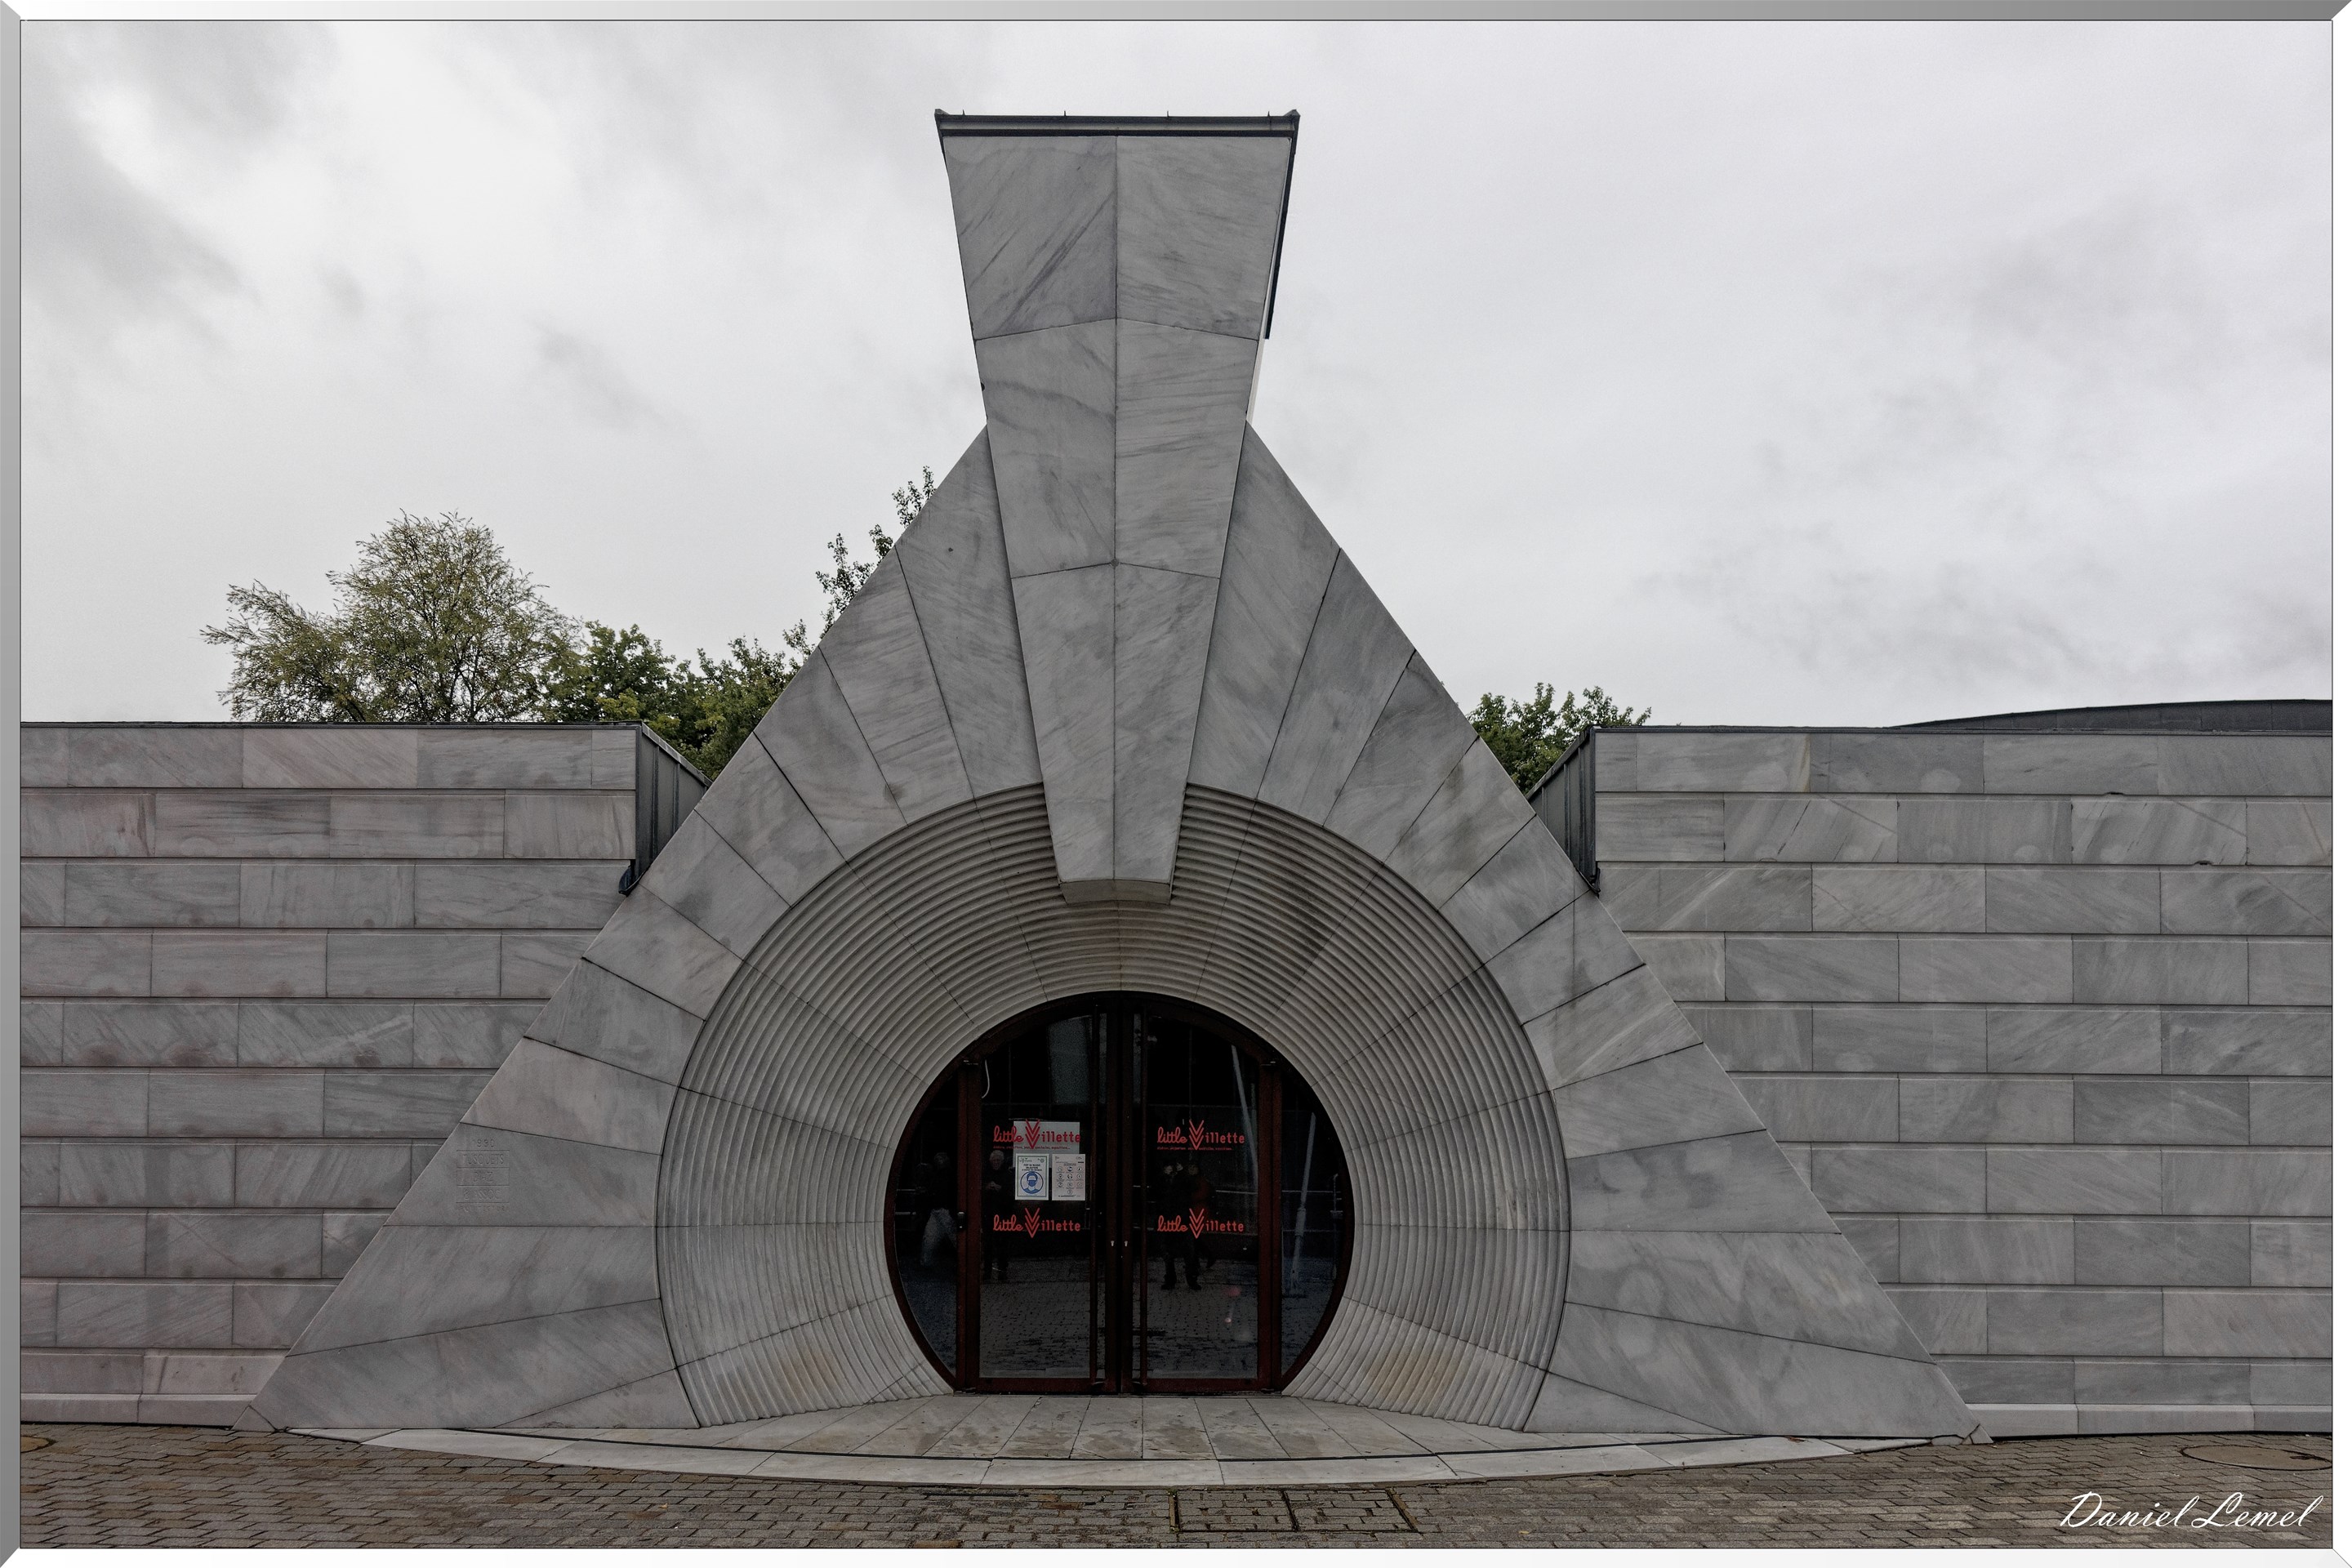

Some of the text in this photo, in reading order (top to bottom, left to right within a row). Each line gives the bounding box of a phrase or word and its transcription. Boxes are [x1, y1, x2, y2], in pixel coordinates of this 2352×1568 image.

[993, 1118, 1081, 1149] little Villette
[1157, 1119, 1245, 1150] little Villette
[993, 1208, 1081, 1238] little Villette
[1157, 1208, 1245, 1239] little Villette
